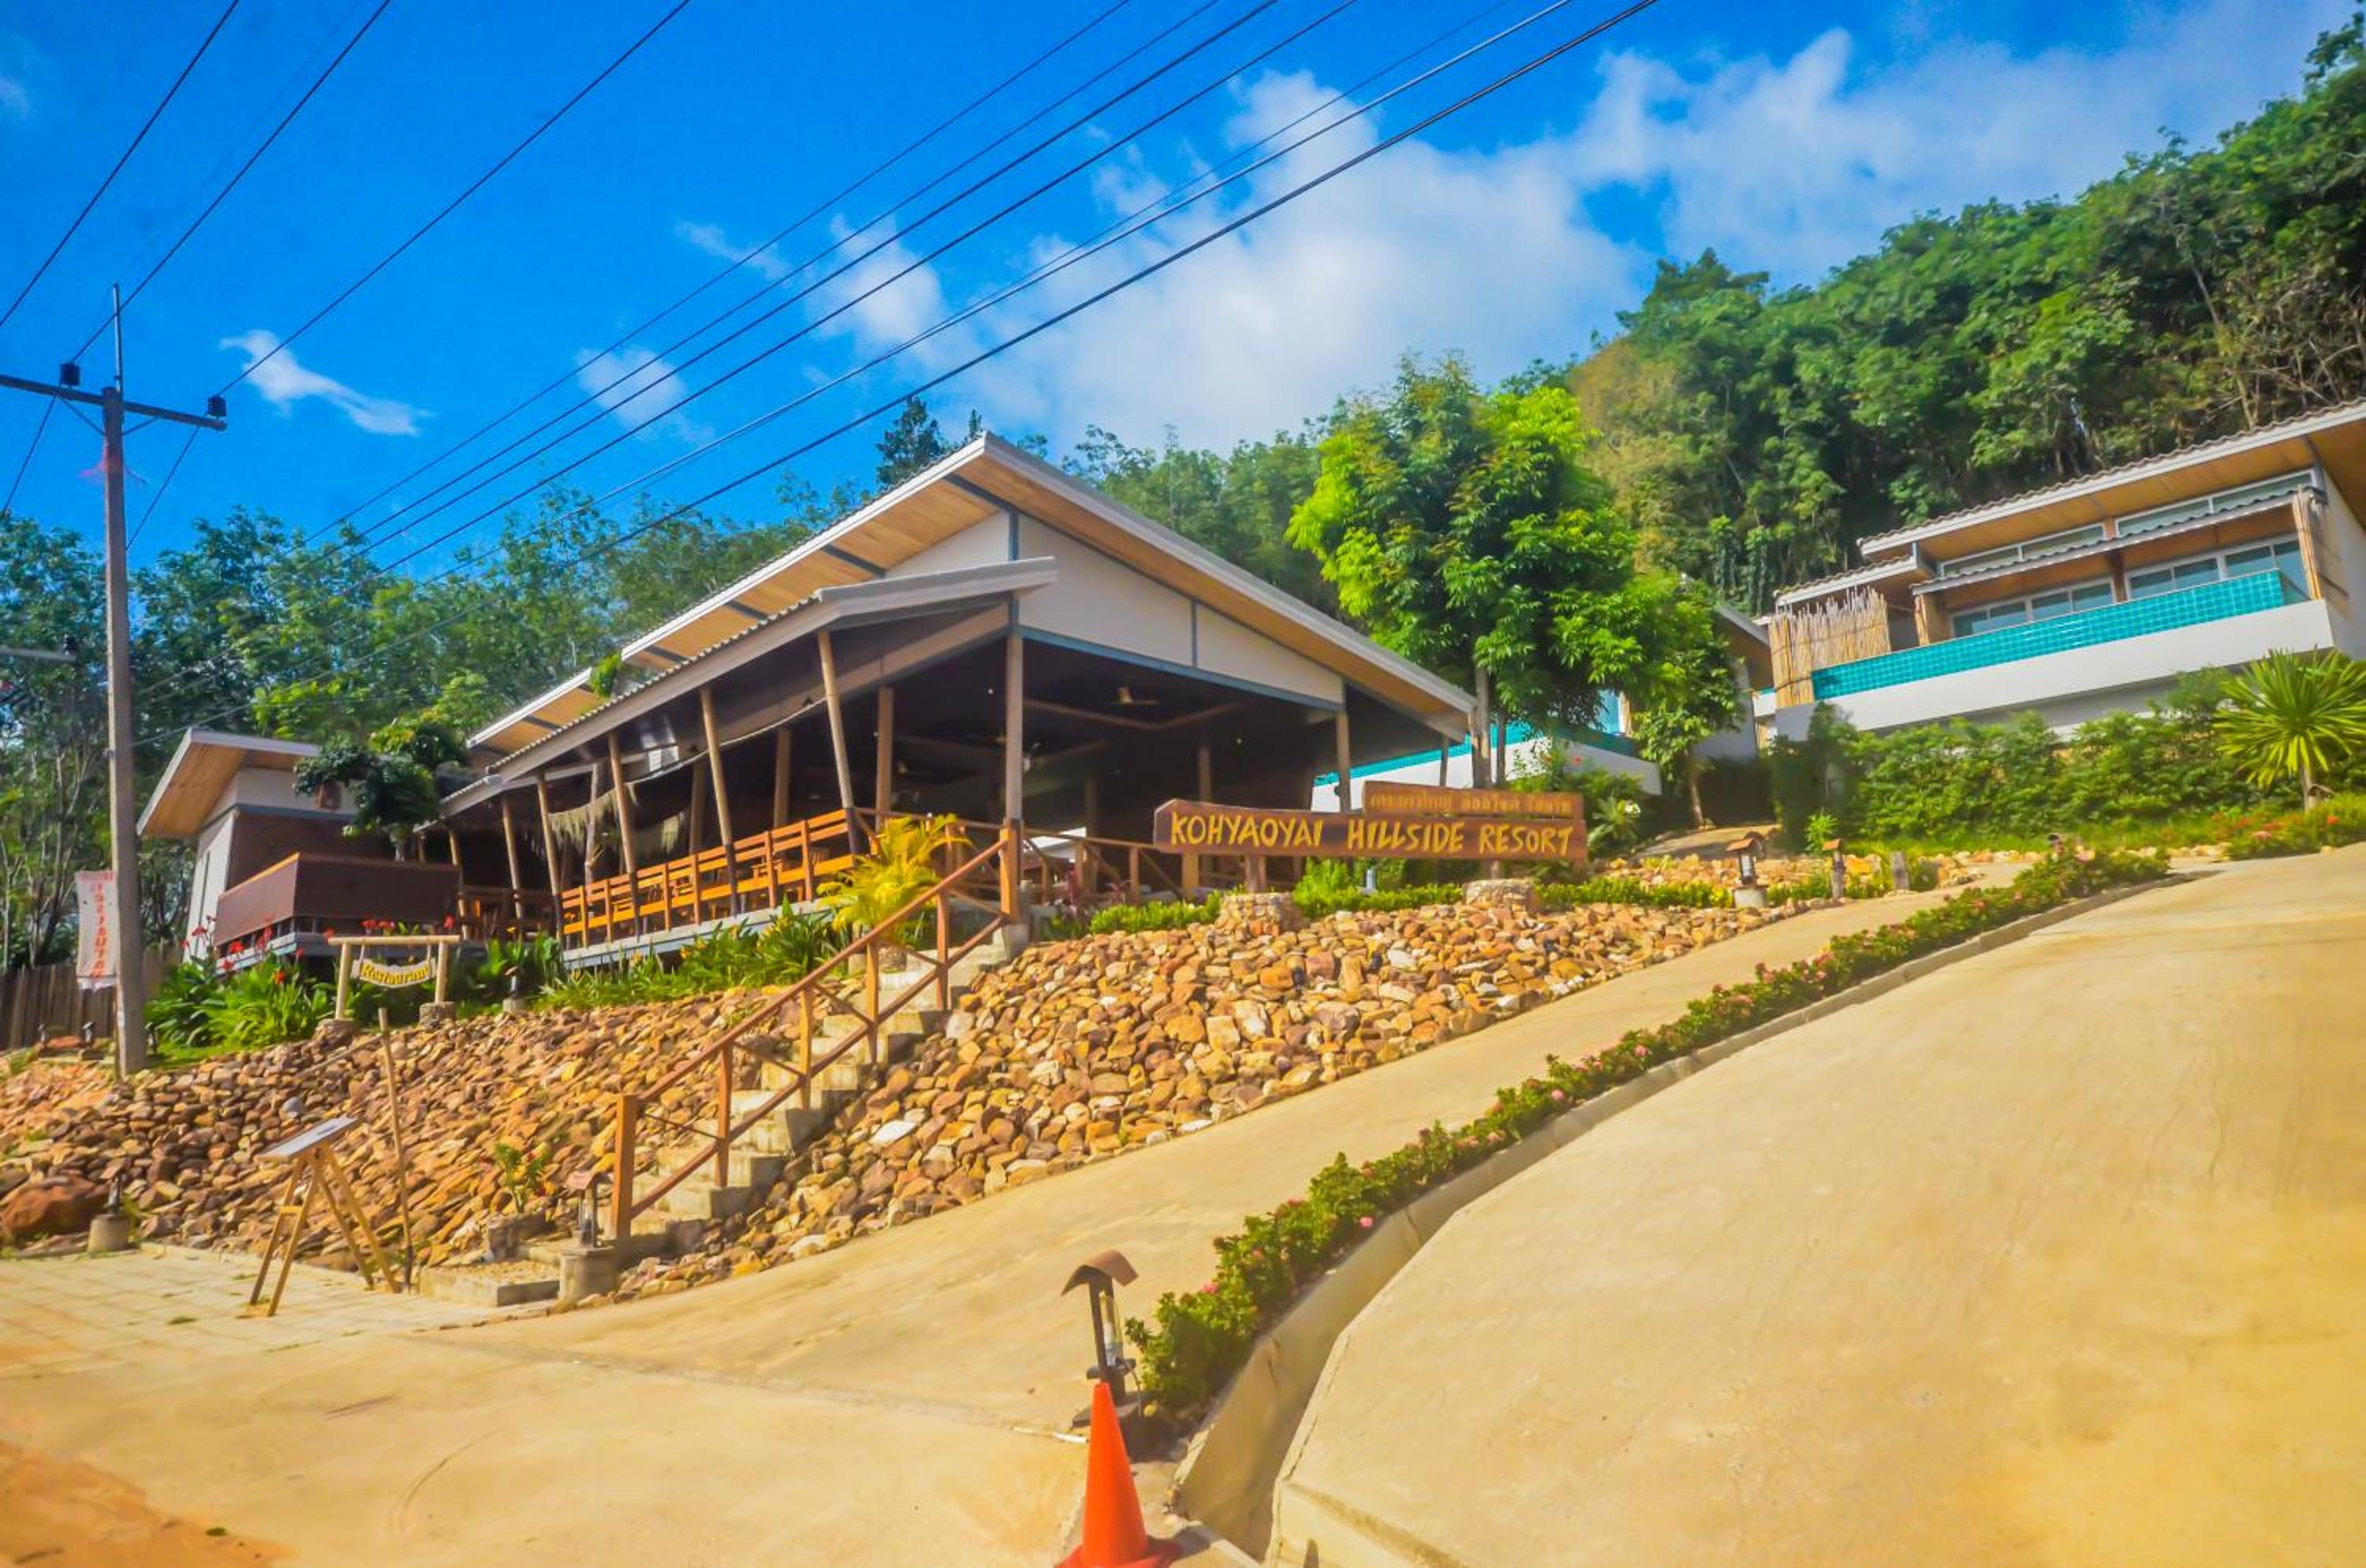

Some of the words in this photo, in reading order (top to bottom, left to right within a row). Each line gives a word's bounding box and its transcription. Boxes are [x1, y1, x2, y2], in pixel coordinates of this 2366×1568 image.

[1170, 811, 1324, 847] KOHYAOYAI
[1347, 818, 1465, 853] HILLSIDE
[1478, 822, 1574, 857] RESORT
[360, 962, 430, 985] Restaurant
